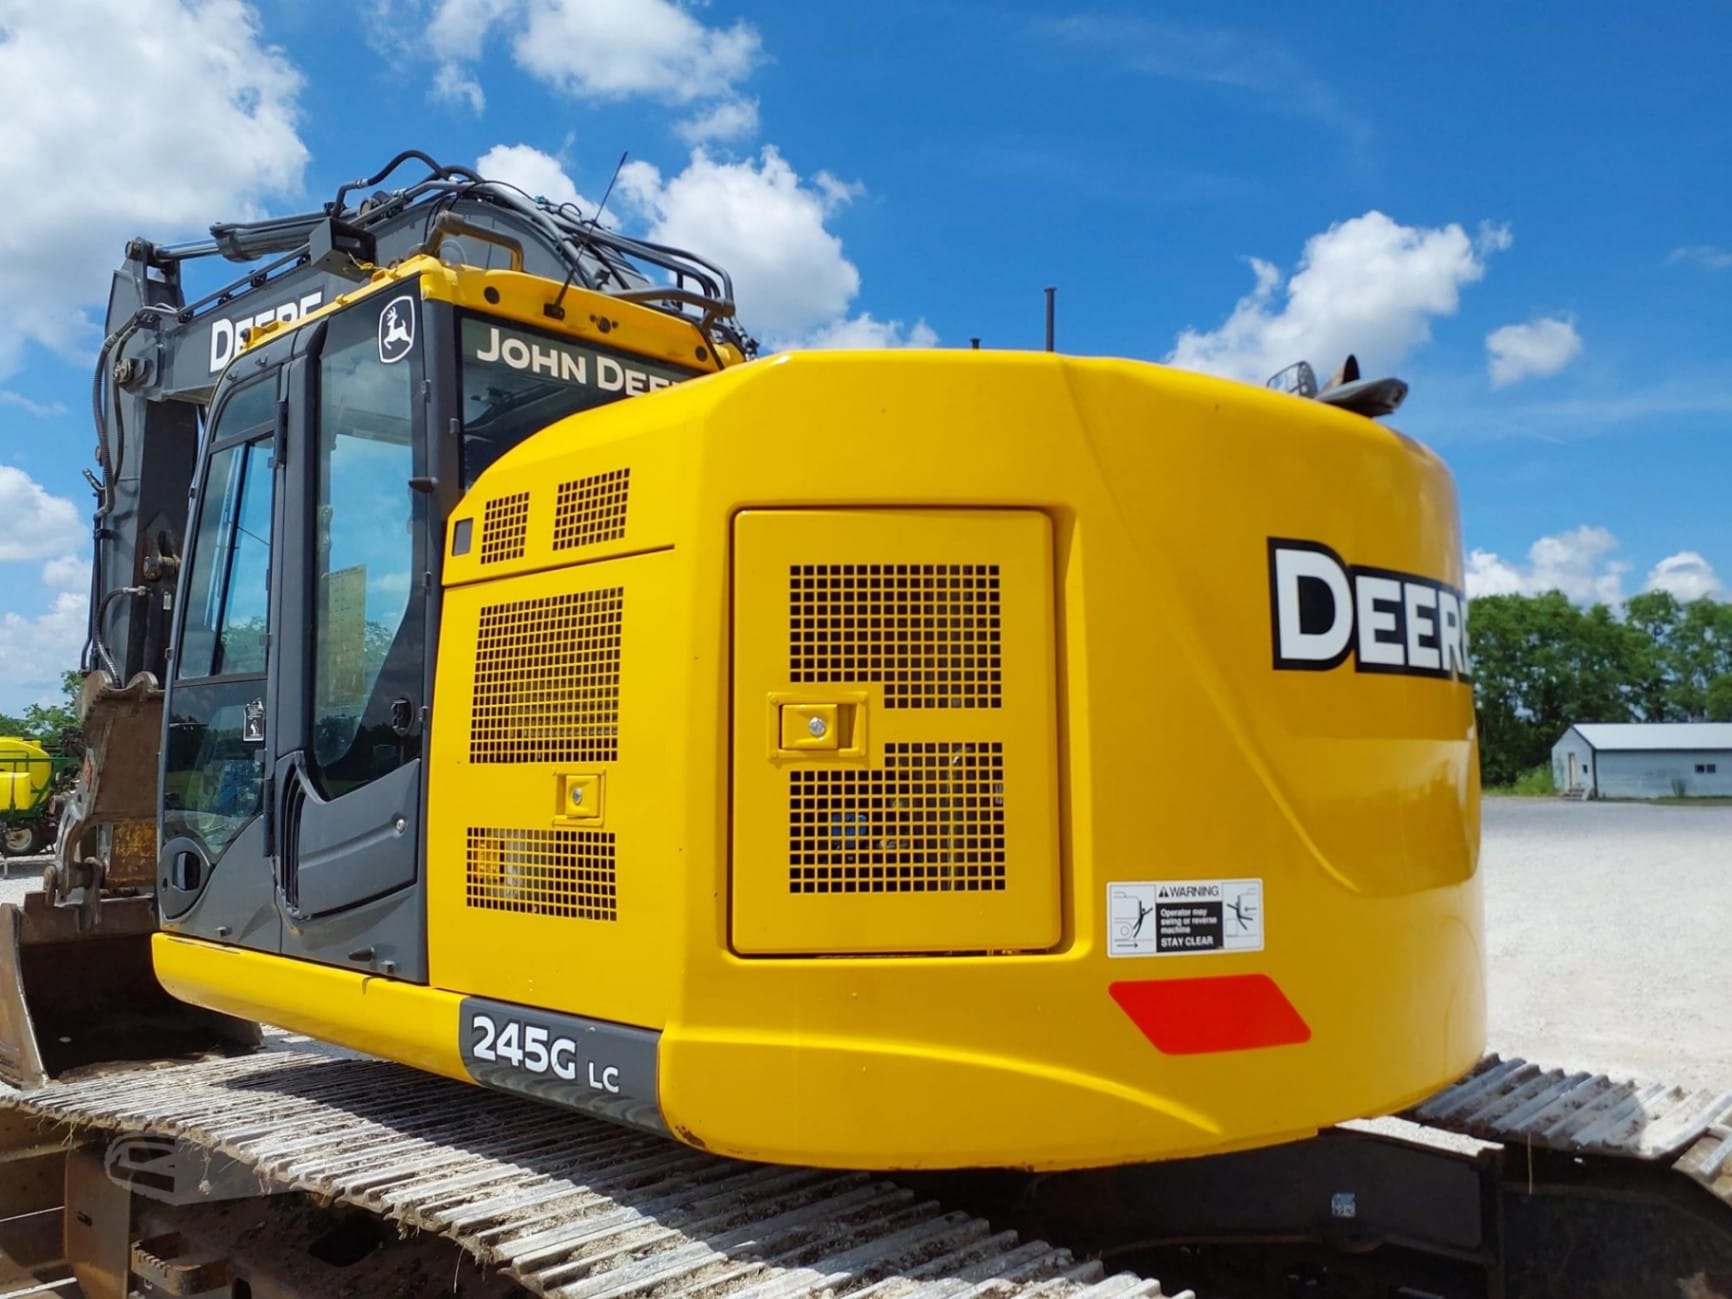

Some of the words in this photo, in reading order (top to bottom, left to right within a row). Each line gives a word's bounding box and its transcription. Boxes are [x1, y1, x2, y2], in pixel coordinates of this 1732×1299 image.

[476, 328, 587, 385] JOHN
[597, 355, 682, 396] DEE
[1274, 547, 1472, 677] DEER
[1169, 885, 1220, 898] WARNING
[1160, 908, 1191, 918] Operator
[1192, 908, 1208, 917] may
[1160, 918, 1182, 928] swing
[1191, 917, 1218, 925] reverse
[1160, 926, 1191, 935] machine
[1160, 937, 1184, 948] STAY
[1185, 935, 1214, 947] CLEAR
[473, 1015, 577, 1081] 245G
[588, 1061, 620, 1093] LC
